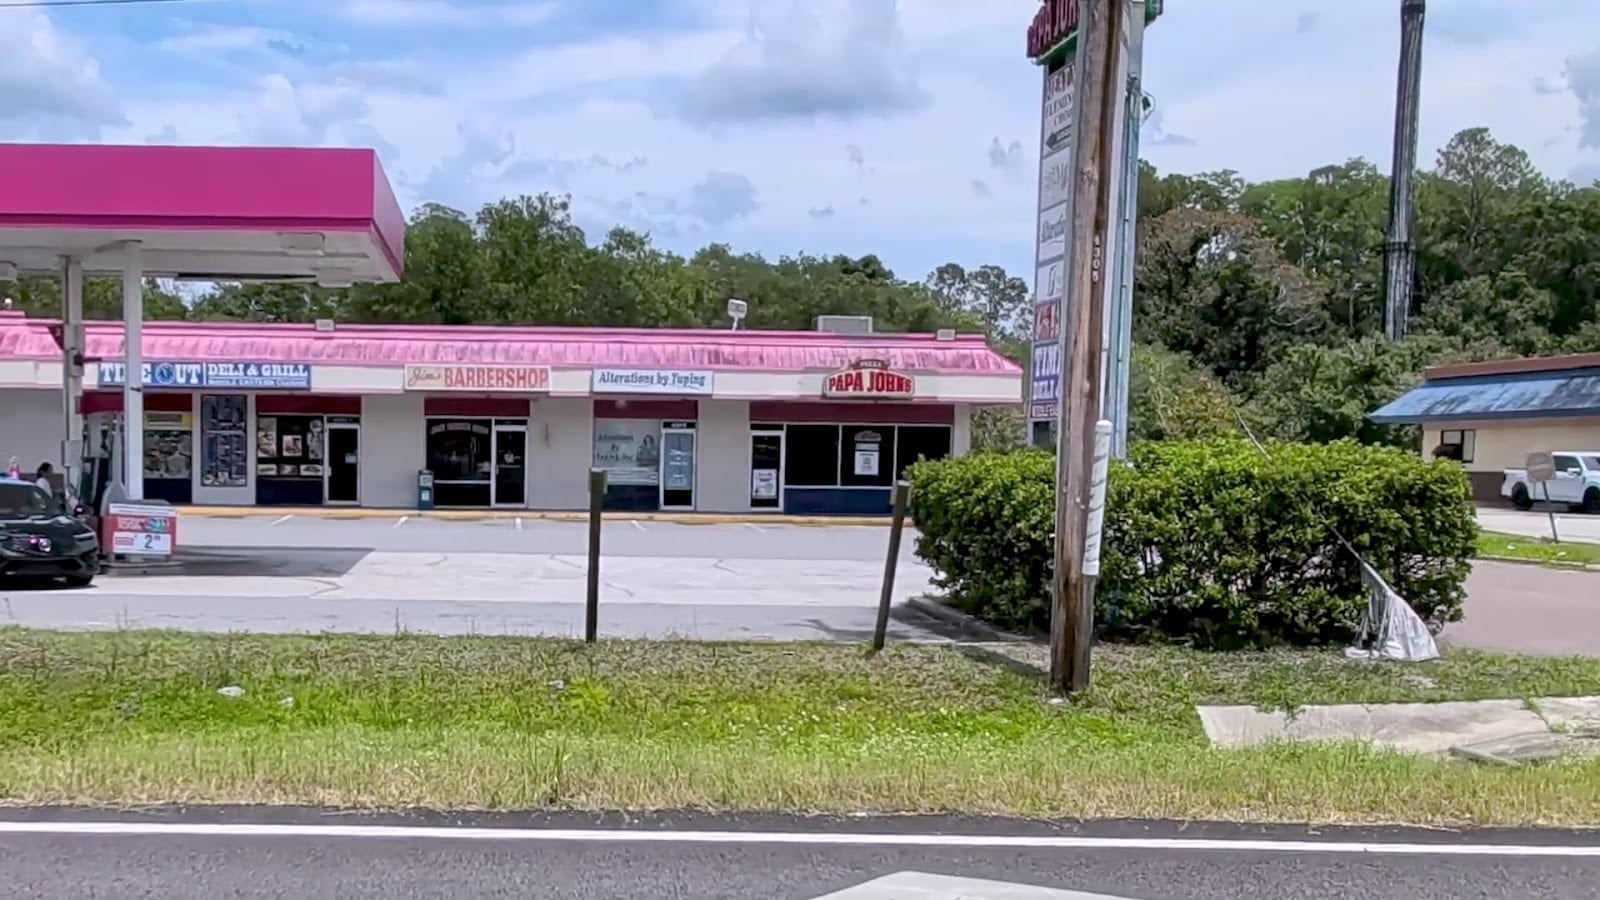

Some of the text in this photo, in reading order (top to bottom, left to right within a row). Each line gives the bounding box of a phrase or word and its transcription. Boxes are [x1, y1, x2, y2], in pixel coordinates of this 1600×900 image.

[100, 362, 151, 383] TIE
[208, 363, 308, 377] DELI & GRILL
[444, 367, 549, 388] BARBERSHOP
[599, 371, 706, 387] Alterations by Yuping
[828, 371, 912, 393] PAPA JOHNS
